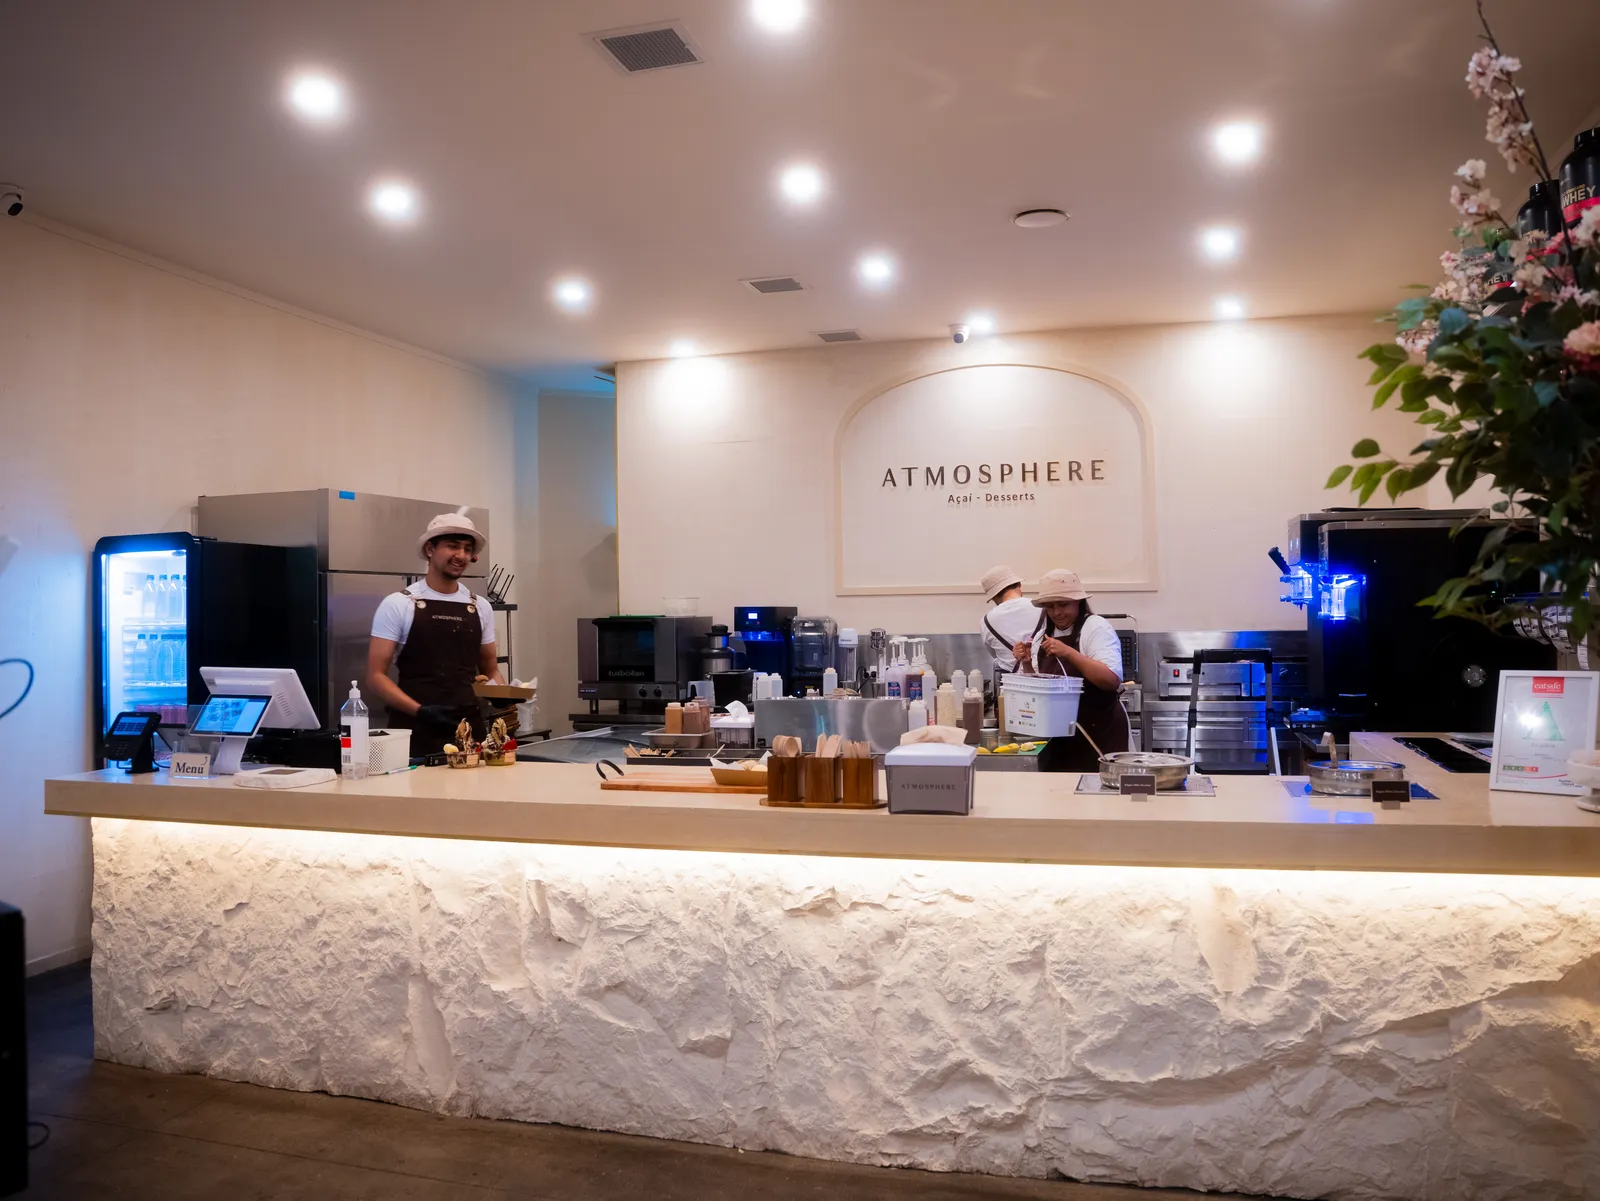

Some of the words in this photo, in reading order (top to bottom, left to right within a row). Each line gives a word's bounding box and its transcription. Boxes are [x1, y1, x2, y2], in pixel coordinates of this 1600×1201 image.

[1561, 185, 1596, 209] WHEY
[882, 459, 1104, 488] ATMOSPHERE
[948, 492, 973, 505] Açaí
[985, 491, 1036, 503] Desserts
[175, 761, 204, 774] Menu
[901, 783, 956, 791] ATMOSPHERE
